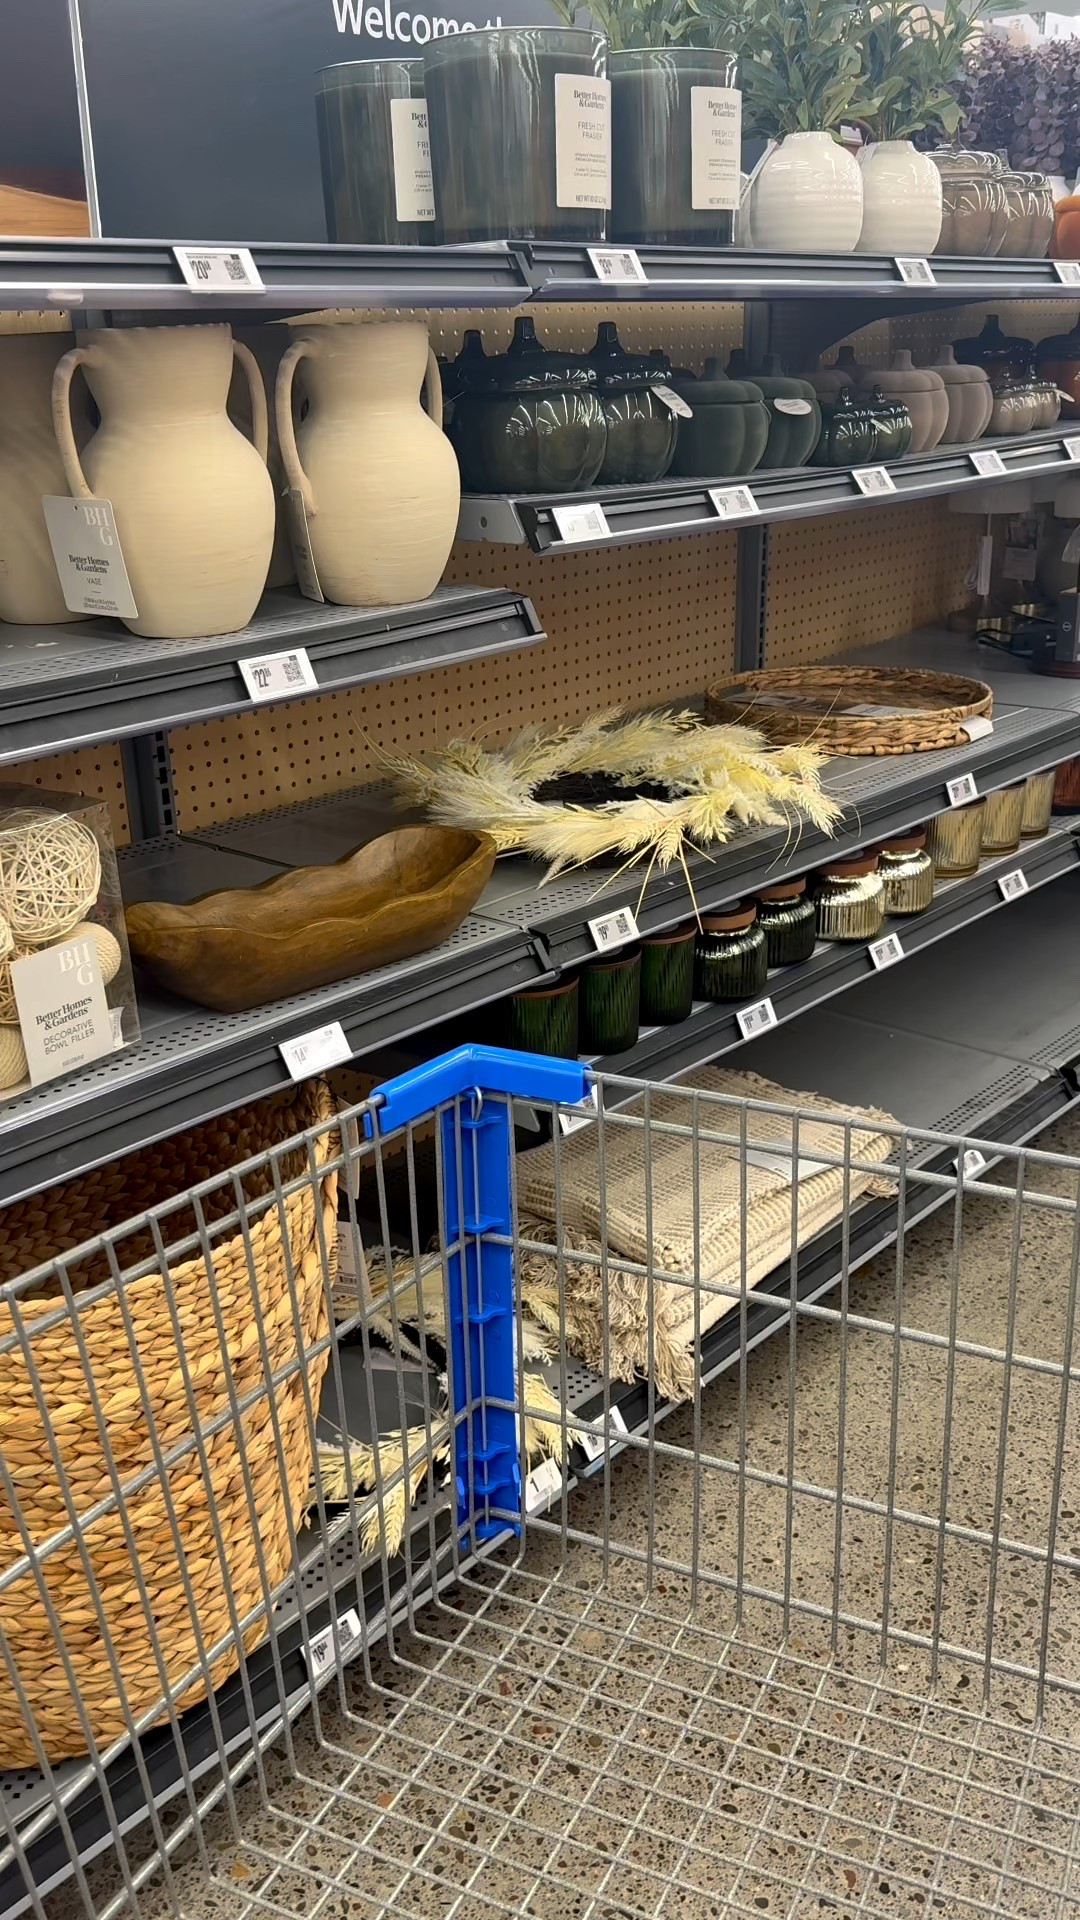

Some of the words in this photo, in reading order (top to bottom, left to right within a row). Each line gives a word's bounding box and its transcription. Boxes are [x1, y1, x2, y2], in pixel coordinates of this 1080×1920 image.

[573, 89, 591, 101] Better
[708, 100, 723, 110] Better
[577, 121, 596, 131] FRESH
[711, 129, 727, 138] FRESH
[100, 526, 114, 546] G
[68, 554, 88, 565] Better
[87, 556, 110, 567] Homes
[81, 563, 108, 574] Gardens
[86, 577, 103, 586] VASE
[77, 963, 94, 986] G
[35, 1007, 62, 1026] Better
[61, 996, 93, 1014] Homes
[44, 1021, 53, 1031] &
[51, 1006, 89, 1028] Gardens
[43, 1019, 94, 1046] DECORATIVE
[44, 1040, 70, 1056] BOWL
[71, 1027, 96, 1045] FILLER
